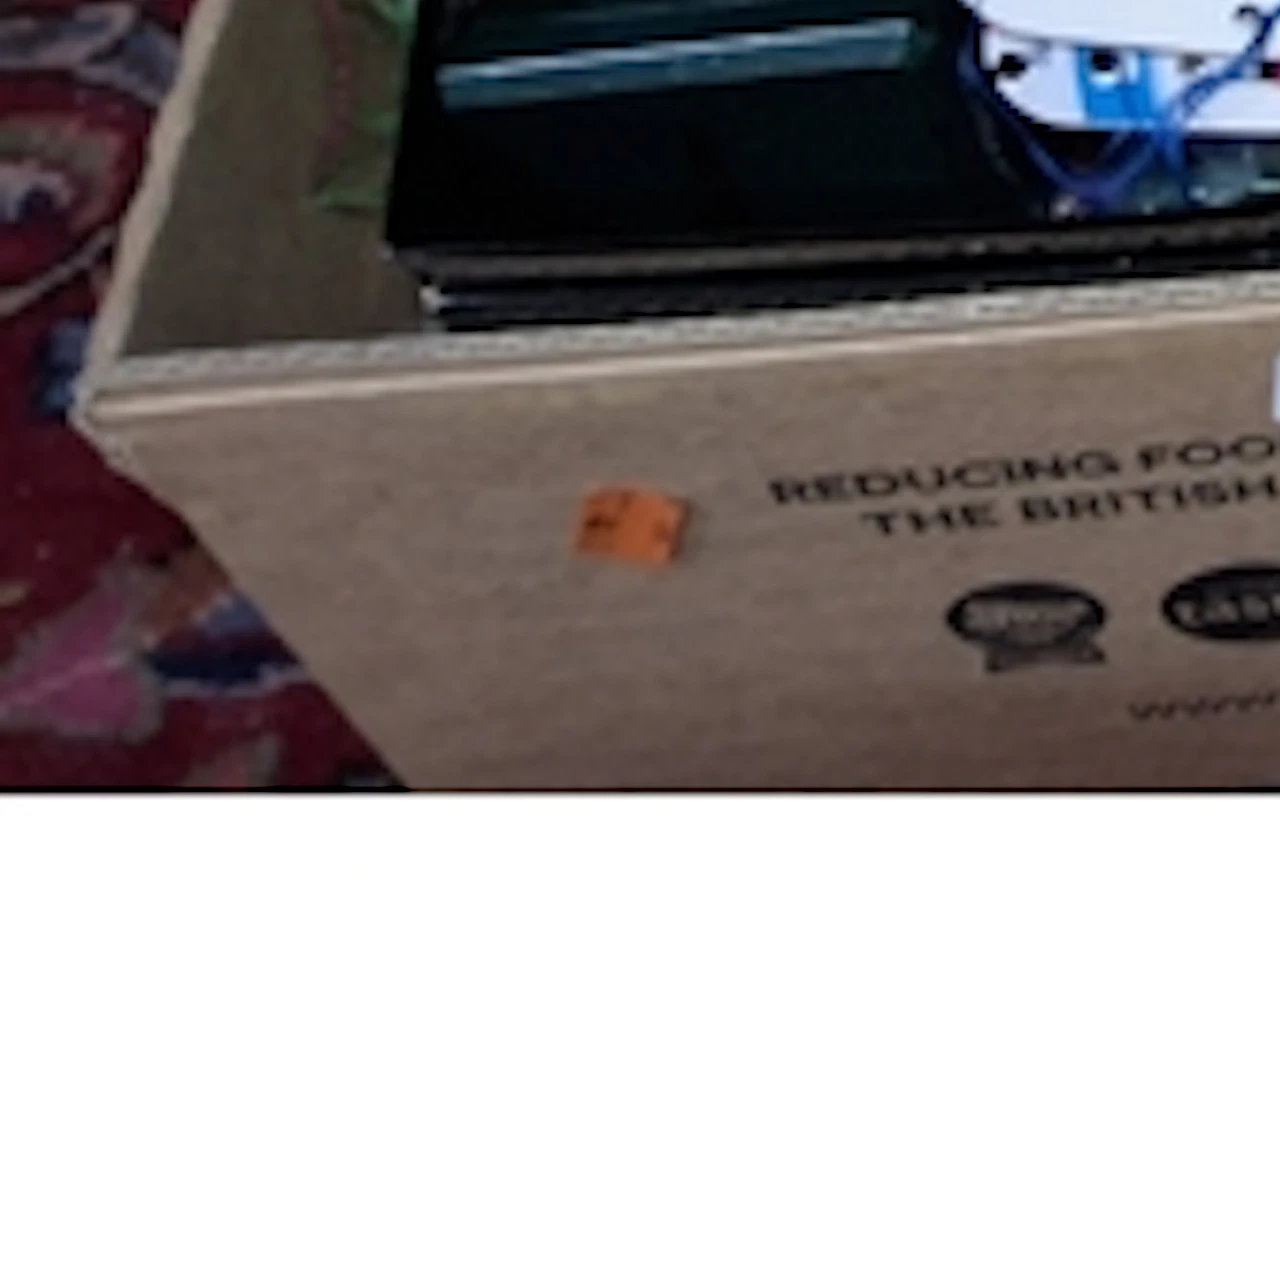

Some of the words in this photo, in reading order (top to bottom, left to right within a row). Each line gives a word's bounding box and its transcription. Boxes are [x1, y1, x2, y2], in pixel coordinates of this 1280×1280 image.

[768, 449, 1120, 506] REDUCING
[860, 501, 1001, 538] THE
[1016, 471, 1280, 524] BRITISH
